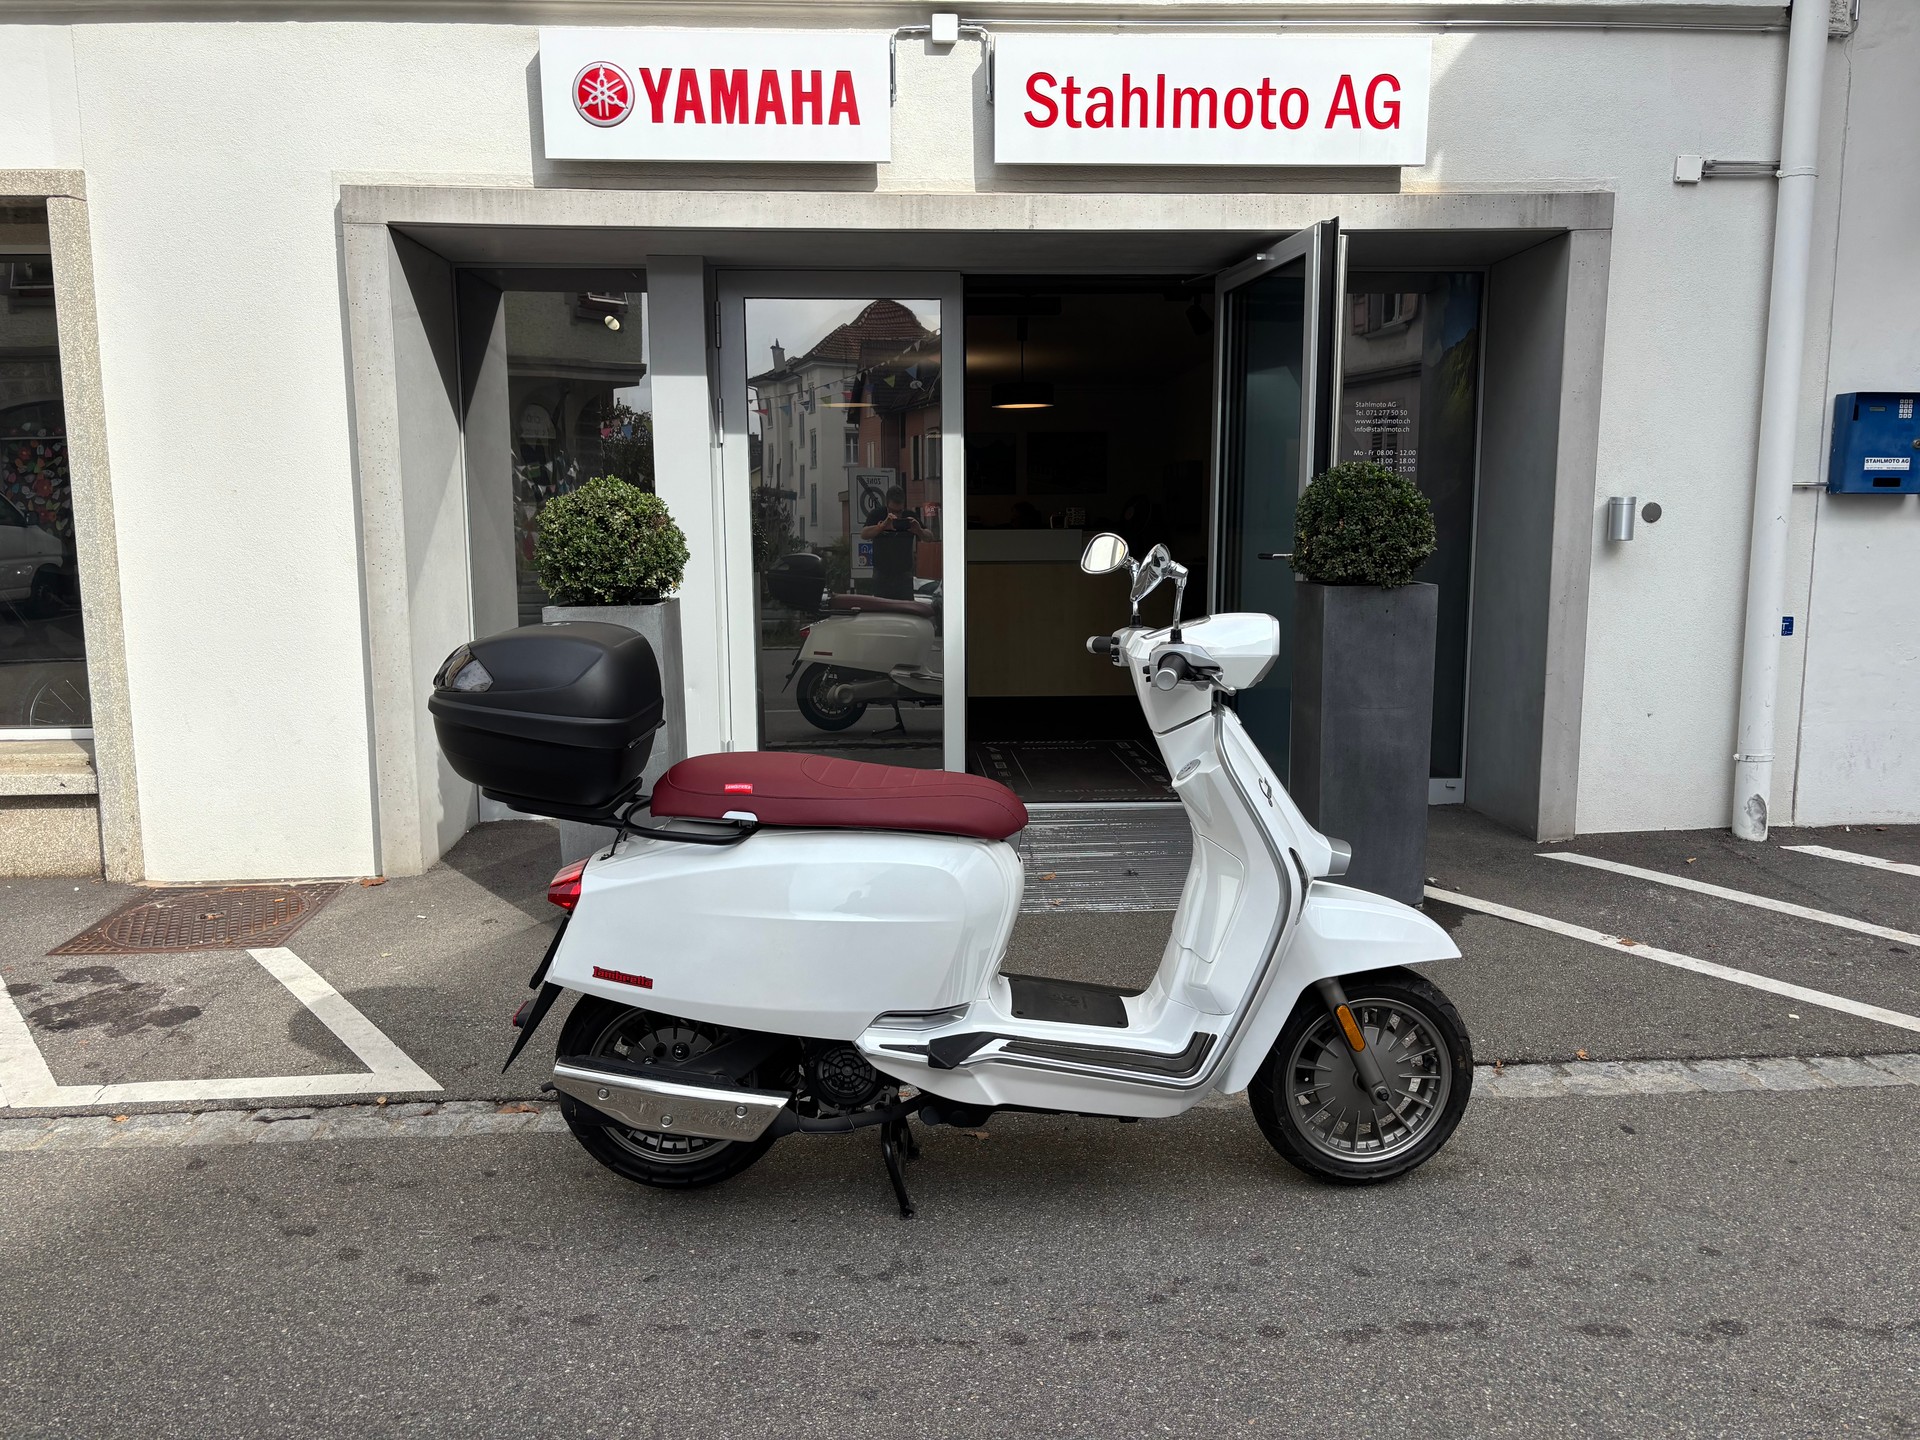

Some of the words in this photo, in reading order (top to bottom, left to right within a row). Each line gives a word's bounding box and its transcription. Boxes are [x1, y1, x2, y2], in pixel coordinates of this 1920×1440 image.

[638, 67, 861, 126] YAMAHA
[1023, 71, 1310, 130] Stahlmoto
[1324, 72, 1402, 130] AG
